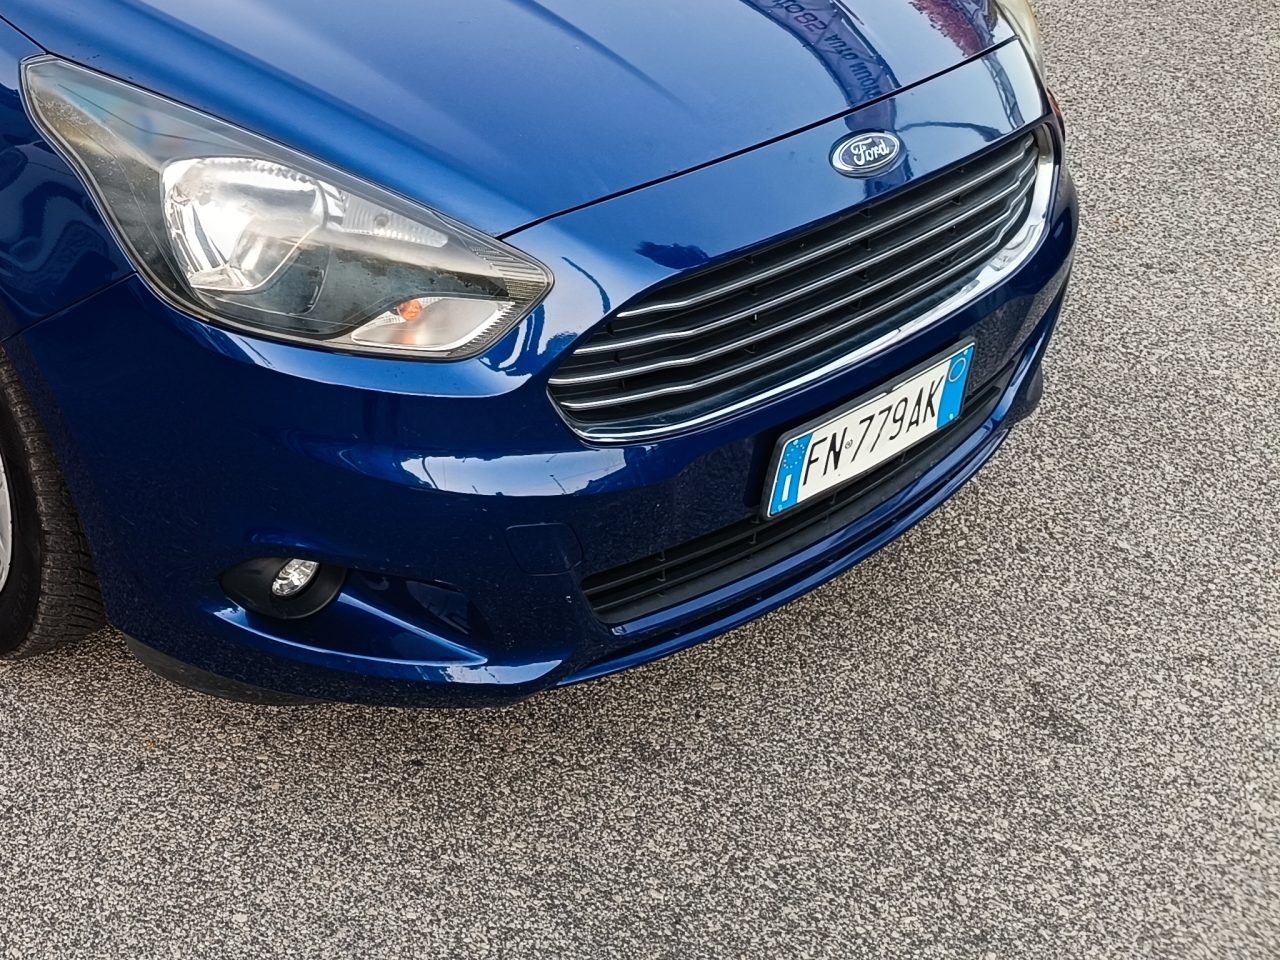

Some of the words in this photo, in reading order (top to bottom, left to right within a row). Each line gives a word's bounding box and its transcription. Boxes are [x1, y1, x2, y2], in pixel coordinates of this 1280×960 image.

[850, 137, 890, 166] Ford
[802, 426, 848, 486] FN
[850, 375, 945, 463] 779AK
